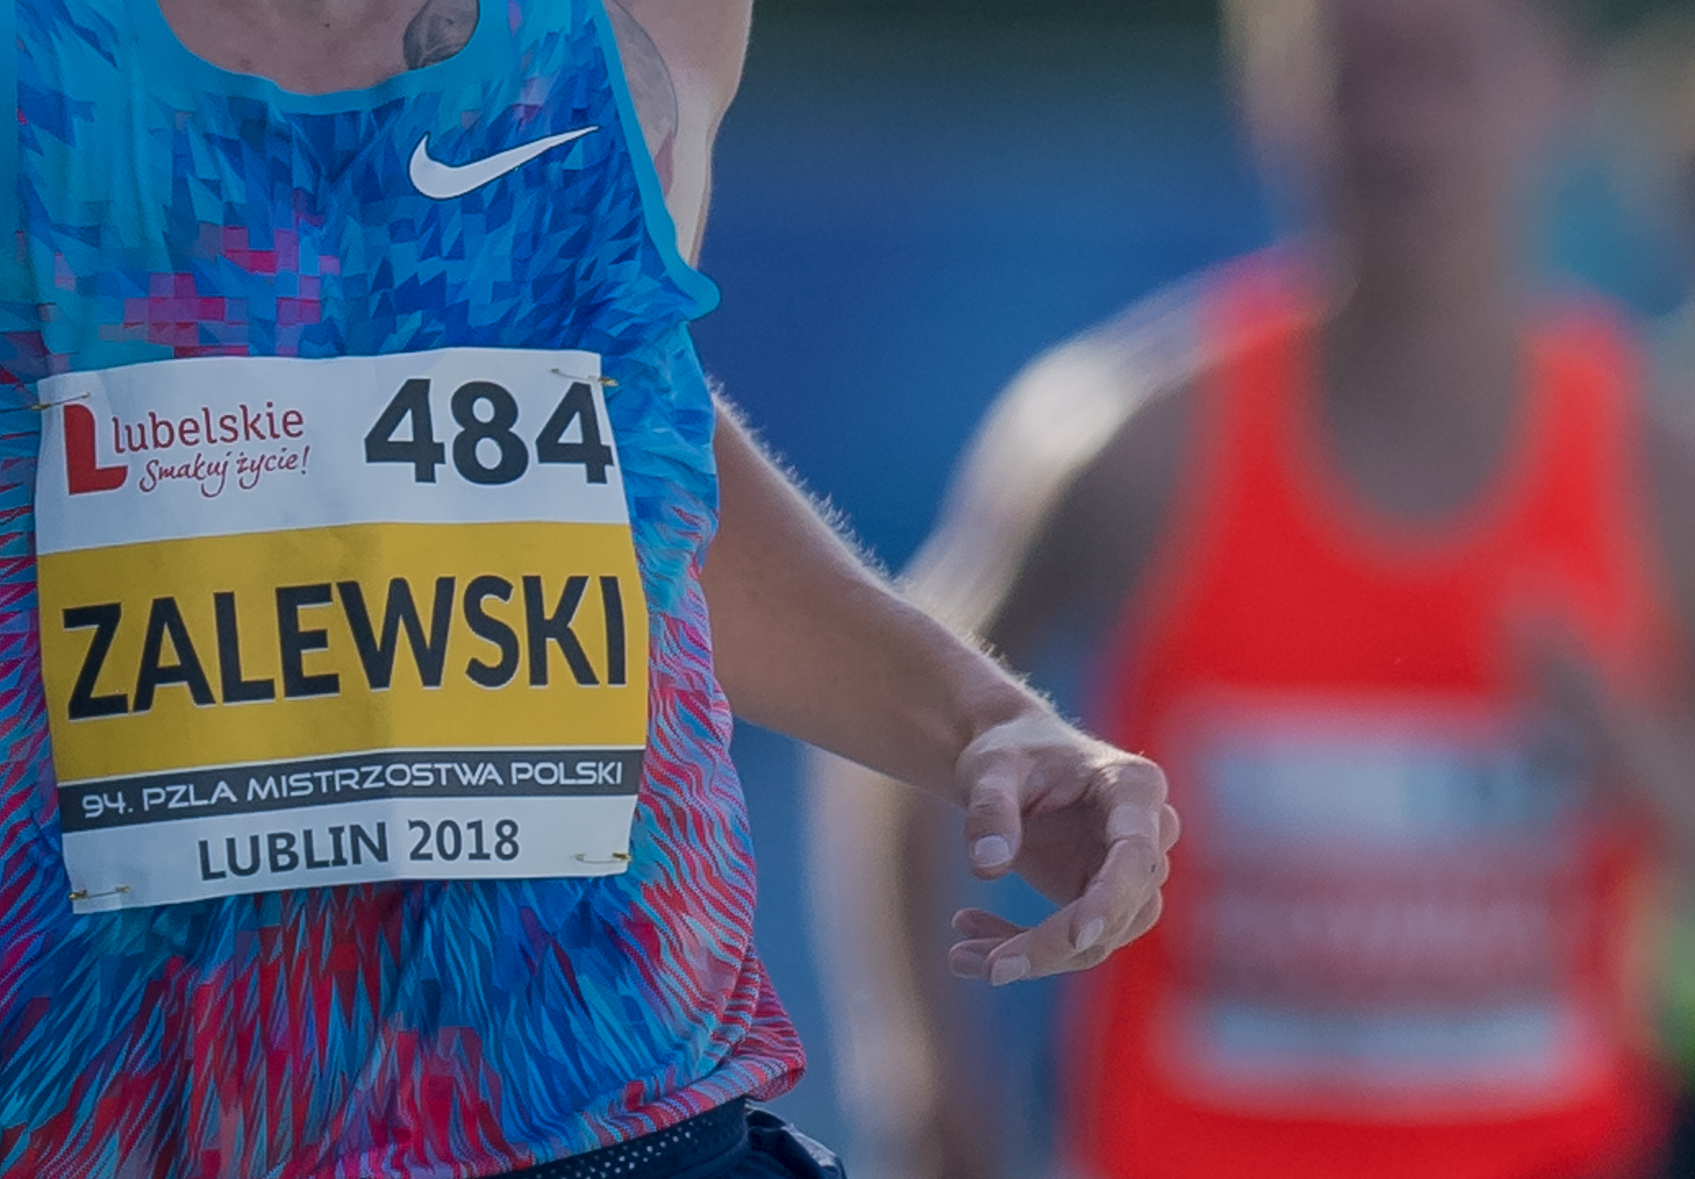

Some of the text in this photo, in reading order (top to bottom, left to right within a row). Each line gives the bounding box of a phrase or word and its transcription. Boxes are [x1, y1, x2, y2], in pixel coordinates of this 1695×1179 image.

[112, 401, 305, 454] lubelskie
[363, 377, 614, 486] 484
[138, 445, 311, 498] Smakuj życie!
[62, 575, 627, 721] ZALEWSKI
[81, 760, 623, 818] 94. PZLA MISTRZOSTWA POLSKI
[198, 819, 520, 882] LUBLIN 2018
